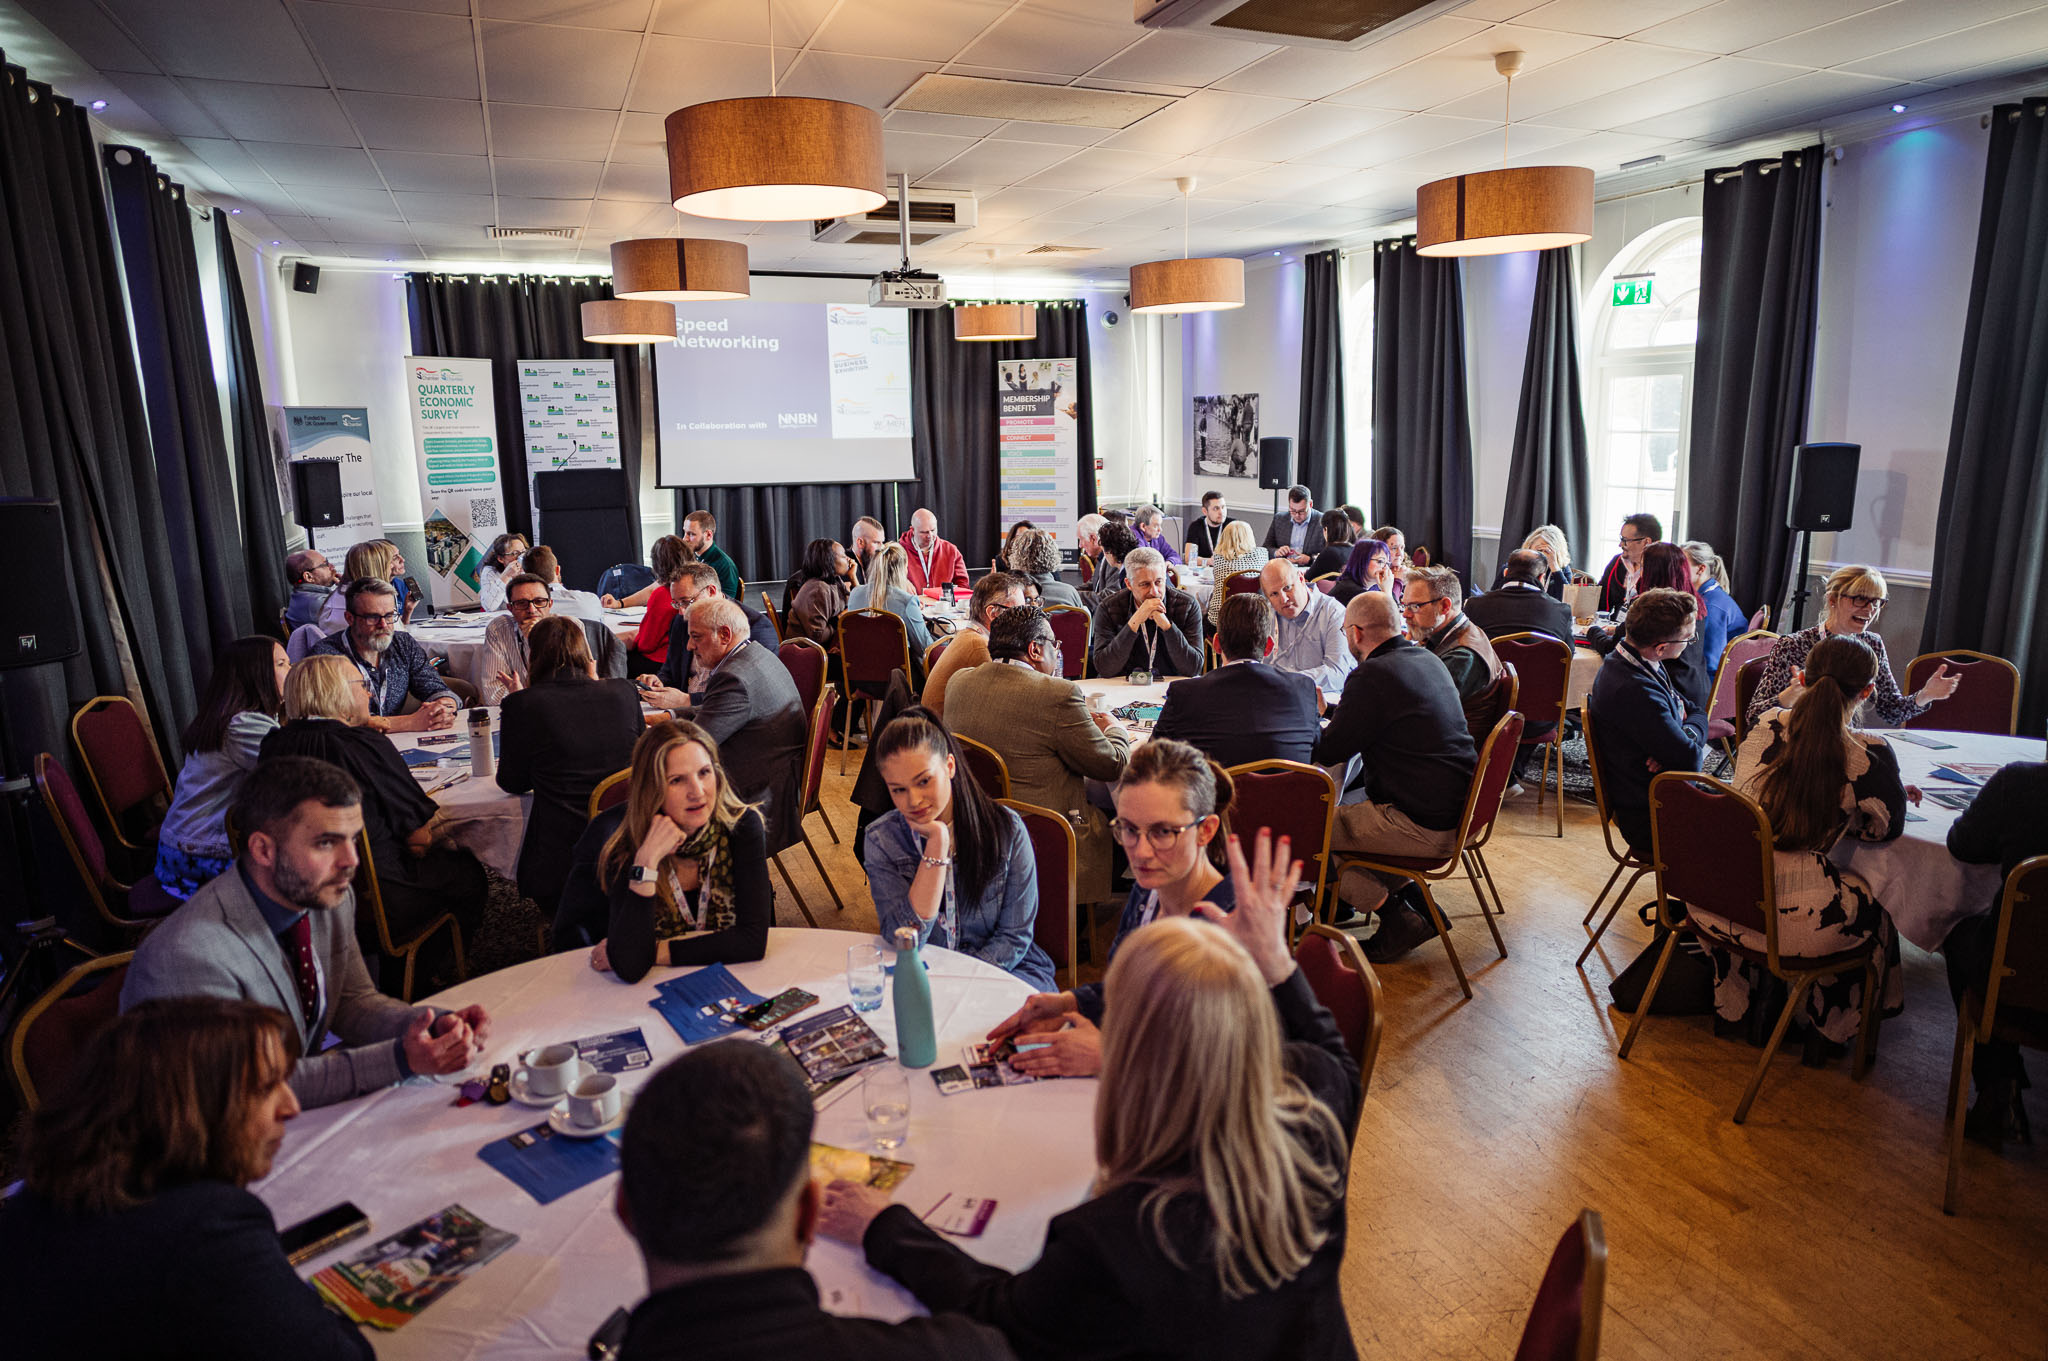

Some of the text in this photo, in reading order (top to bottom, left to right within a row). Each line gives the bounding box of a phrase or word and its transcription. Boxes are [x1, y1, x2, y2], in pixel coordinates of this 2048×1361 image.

[676, 317, 728, 334] Speed
[673, 335, 779, 352] Networking
[418, 384, 475, 396] QUARTERLY
[419, 397, 474, 407] ECONOMIC
[1003, 395, 1050, 403] MEMBERSHIP
[1003, 404, 1036, 412] BENEFITS
[421, 409, 459, 420] SURVEY
[778, 412, 817, 425] NNBN
[676, 422, 768, 430] In Collaboration with
[345, 452, 362, 463] The
